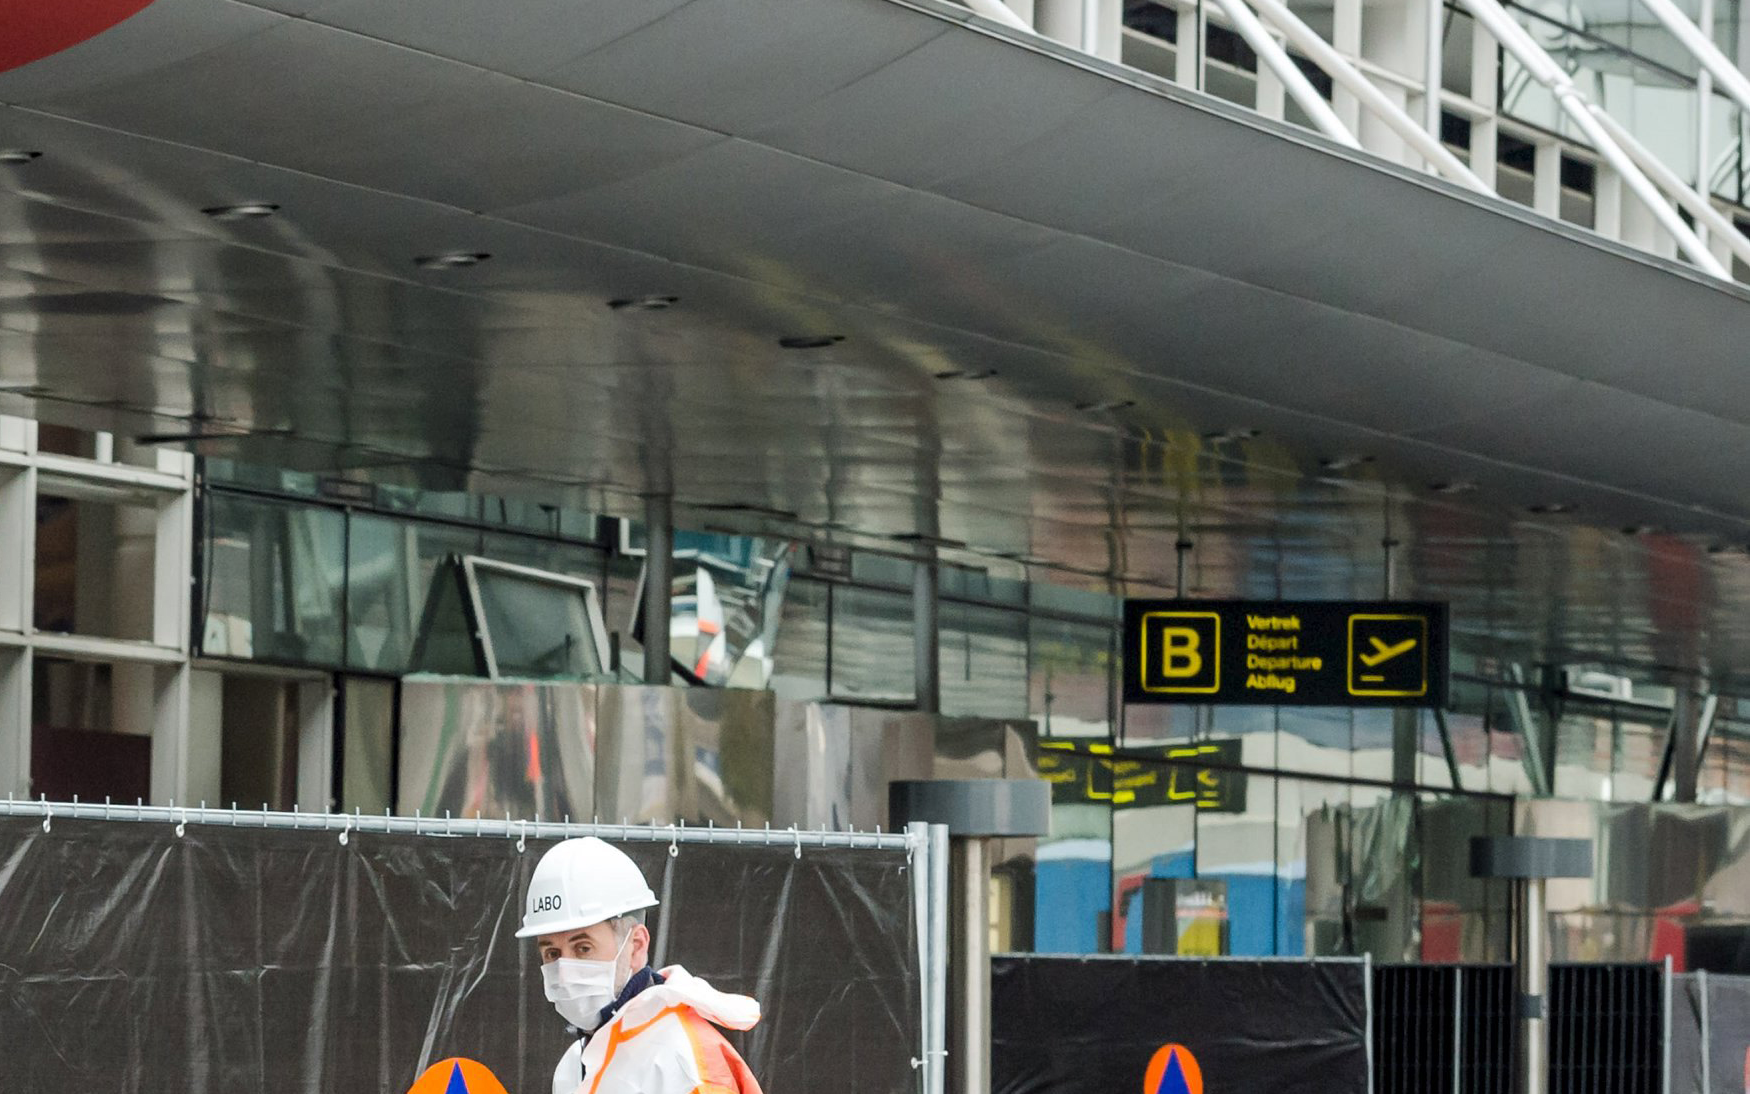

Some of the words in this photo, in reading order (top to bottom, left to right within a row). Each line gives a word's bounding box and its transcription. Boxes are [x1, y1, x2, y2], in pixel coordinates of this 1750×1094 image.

[1246, 615, 1300, 630] Vertrek
[1247, 633, 1298, 651] Départ
[1162, 627, 1202, 678] B
[1247, 654, 1322, 671] Departure
[1246, 674, 1296, 694] Abflug
[533, 895, 562, 913] LABO
